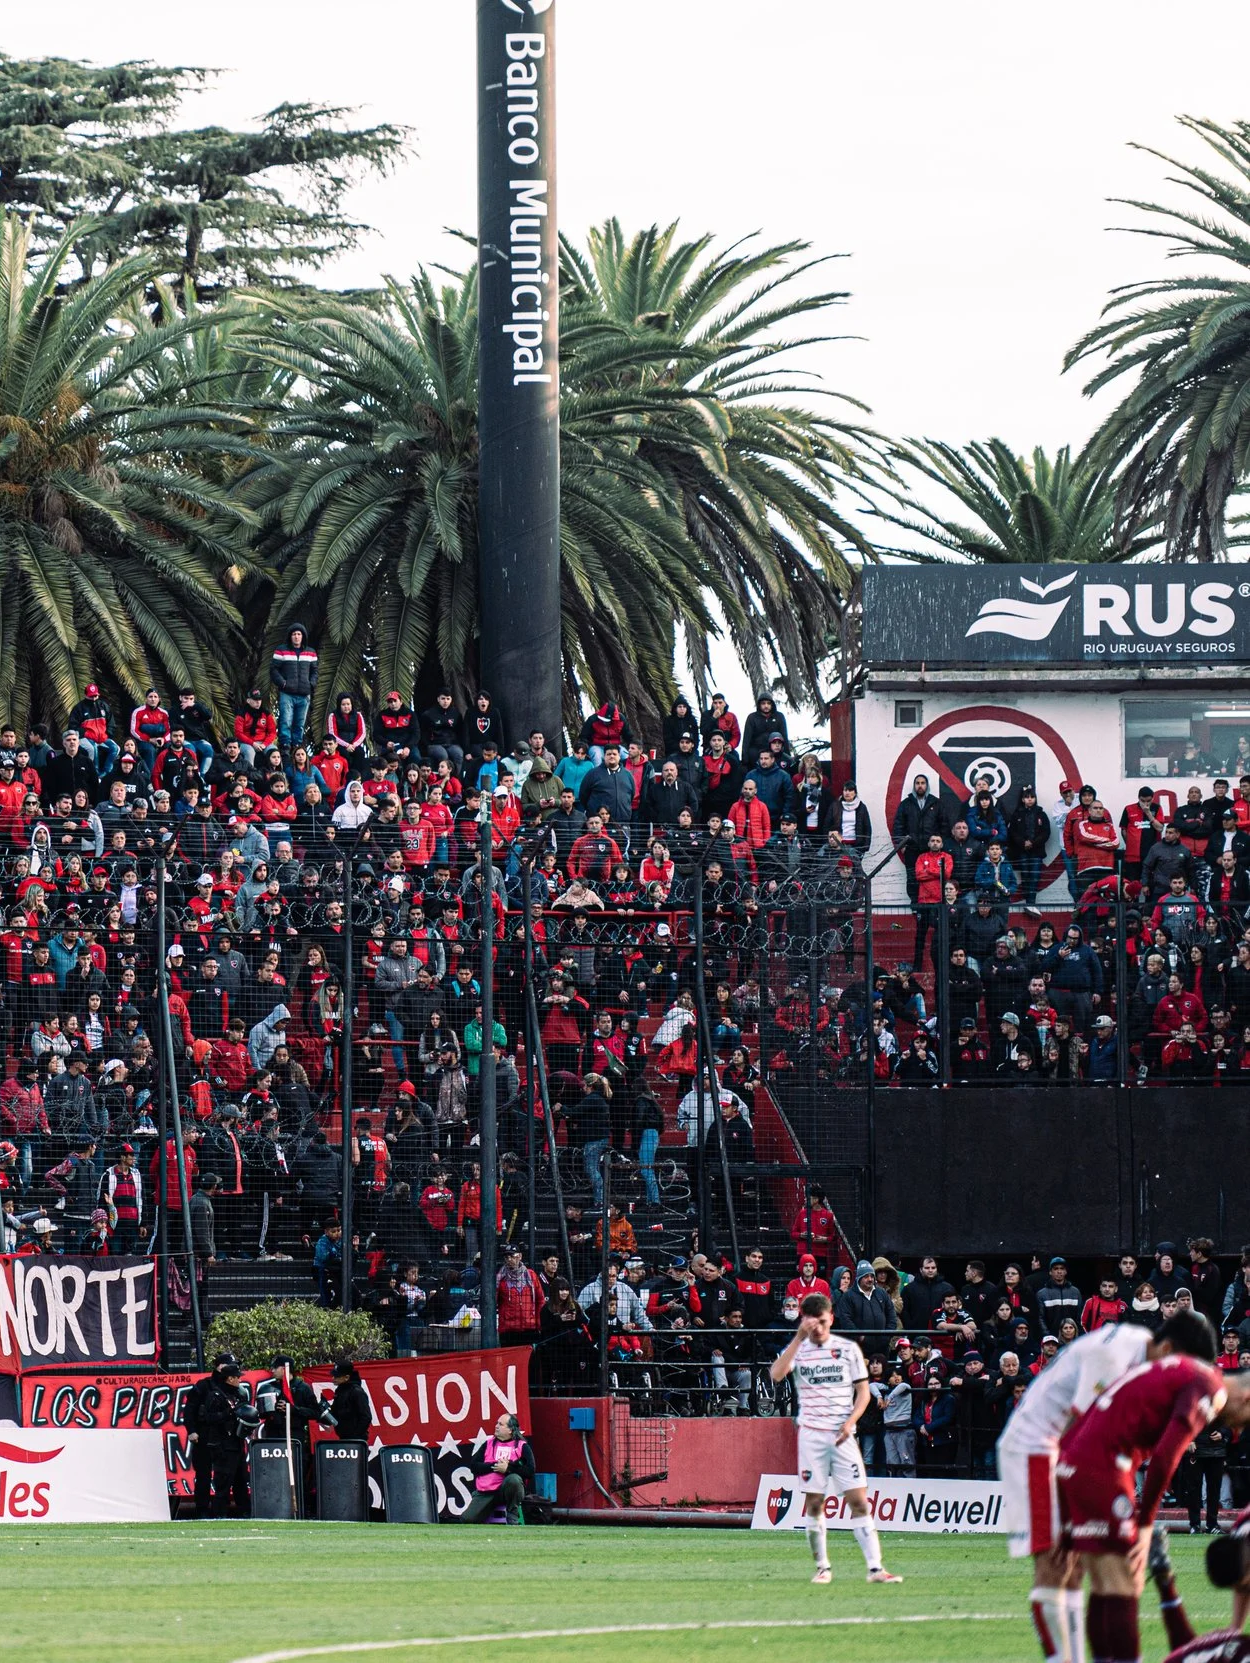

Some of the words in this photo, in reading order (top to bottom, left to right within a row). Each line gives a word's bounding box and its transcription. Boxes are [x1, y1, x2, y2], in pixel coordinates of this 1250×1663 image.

[505, 32, 545, 165] Banco
[502, 179, 553, 386] Municipal
[1083, 582, 1236, 637] RUS
[1083, 643, 1106, 654] RIO
[1110, 642, 1172, 653] URUGUAY
[1175, 642, 1236, 653] SEGUROS
[31, 1384, 99, 1428] LOS
[111, 1381, 194, 1428] PIBE
[325, 1448, 358, 1459] B.O.U
[391, 1453, 423, 1464] B.O.U
[851, 1463, 860, 1479] 3
[769, 1497, 788, 1508] NOB
[801, 1490, 897, 1522] eda
